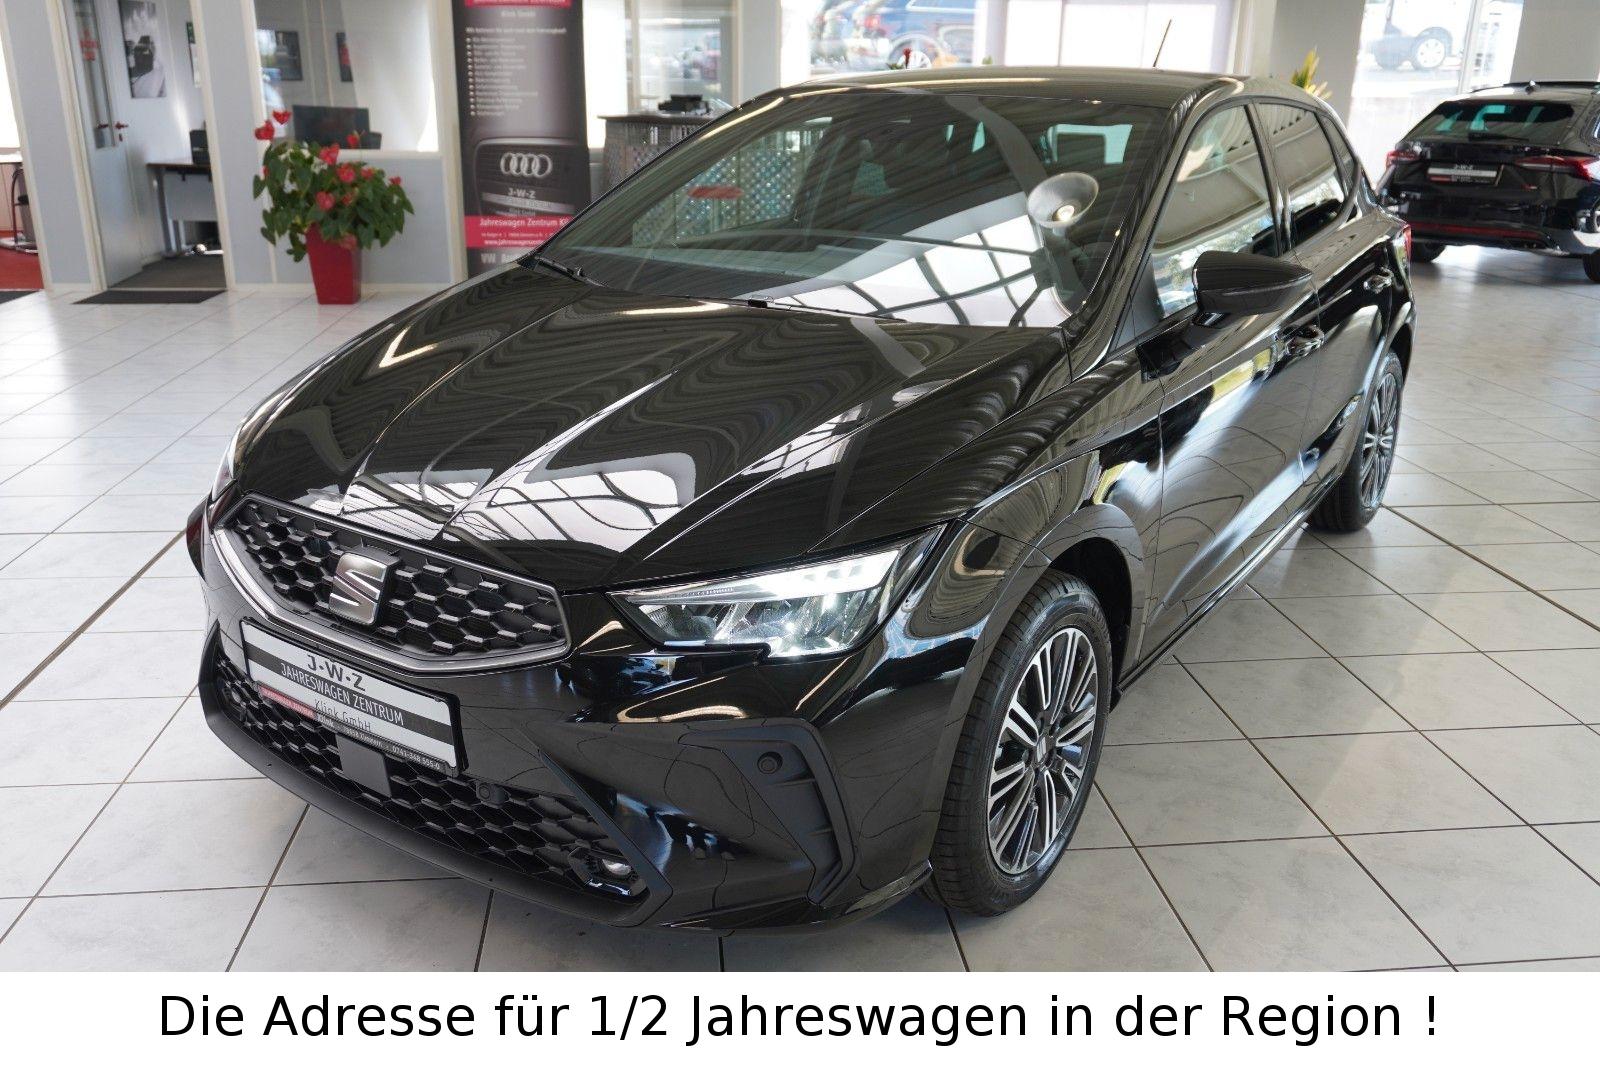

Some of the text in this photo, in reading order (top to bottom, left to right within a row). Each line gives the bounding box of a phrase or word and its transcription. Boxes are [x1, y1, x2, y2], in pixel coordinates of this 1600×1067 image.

[480, 218, 525, 228] Jahreswagen
[528, 217, 557, 227] Zentrum
[481, 253, 496, 264] VW
[280, 662, 351, 705] JAHRESWAGEN
[352, 693, 405, 726] ZENTRUM
